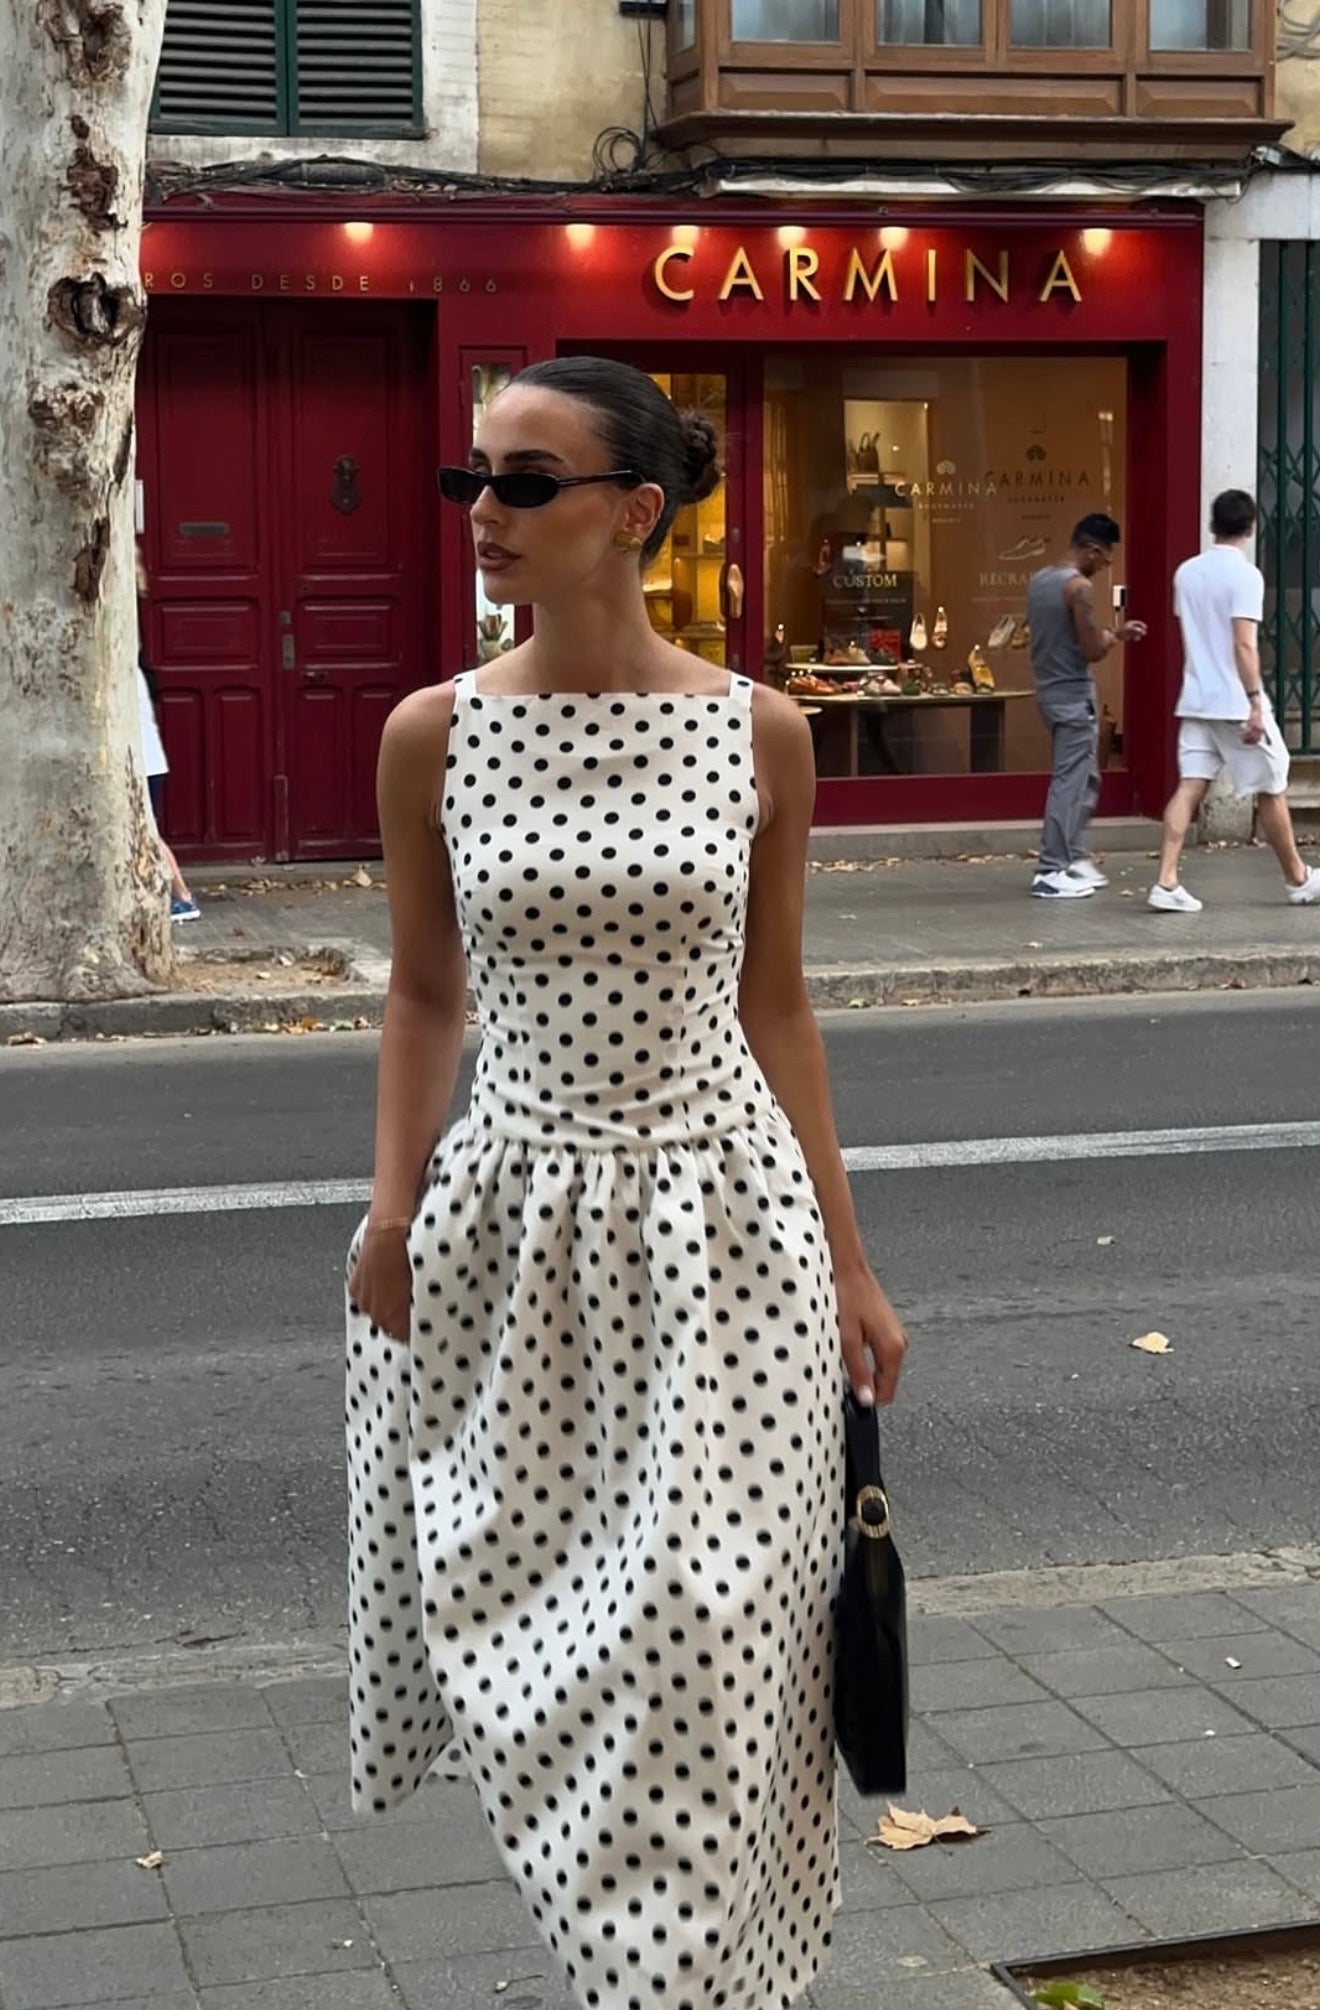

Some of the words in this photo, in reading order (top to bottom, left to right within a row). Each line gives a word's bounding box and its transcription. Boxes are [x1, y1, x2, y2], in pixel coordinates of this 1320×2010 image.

[654, 246, 1082, 302] CARMINA
[251, 274, 369, 291] DESDE
[410, 277, 496, 293] 1866
[985, 470, 1089, 487] CARMINA
[895, 481, 997, 497] CARMINA
[833, 574, 897, 588] CUSTOM
